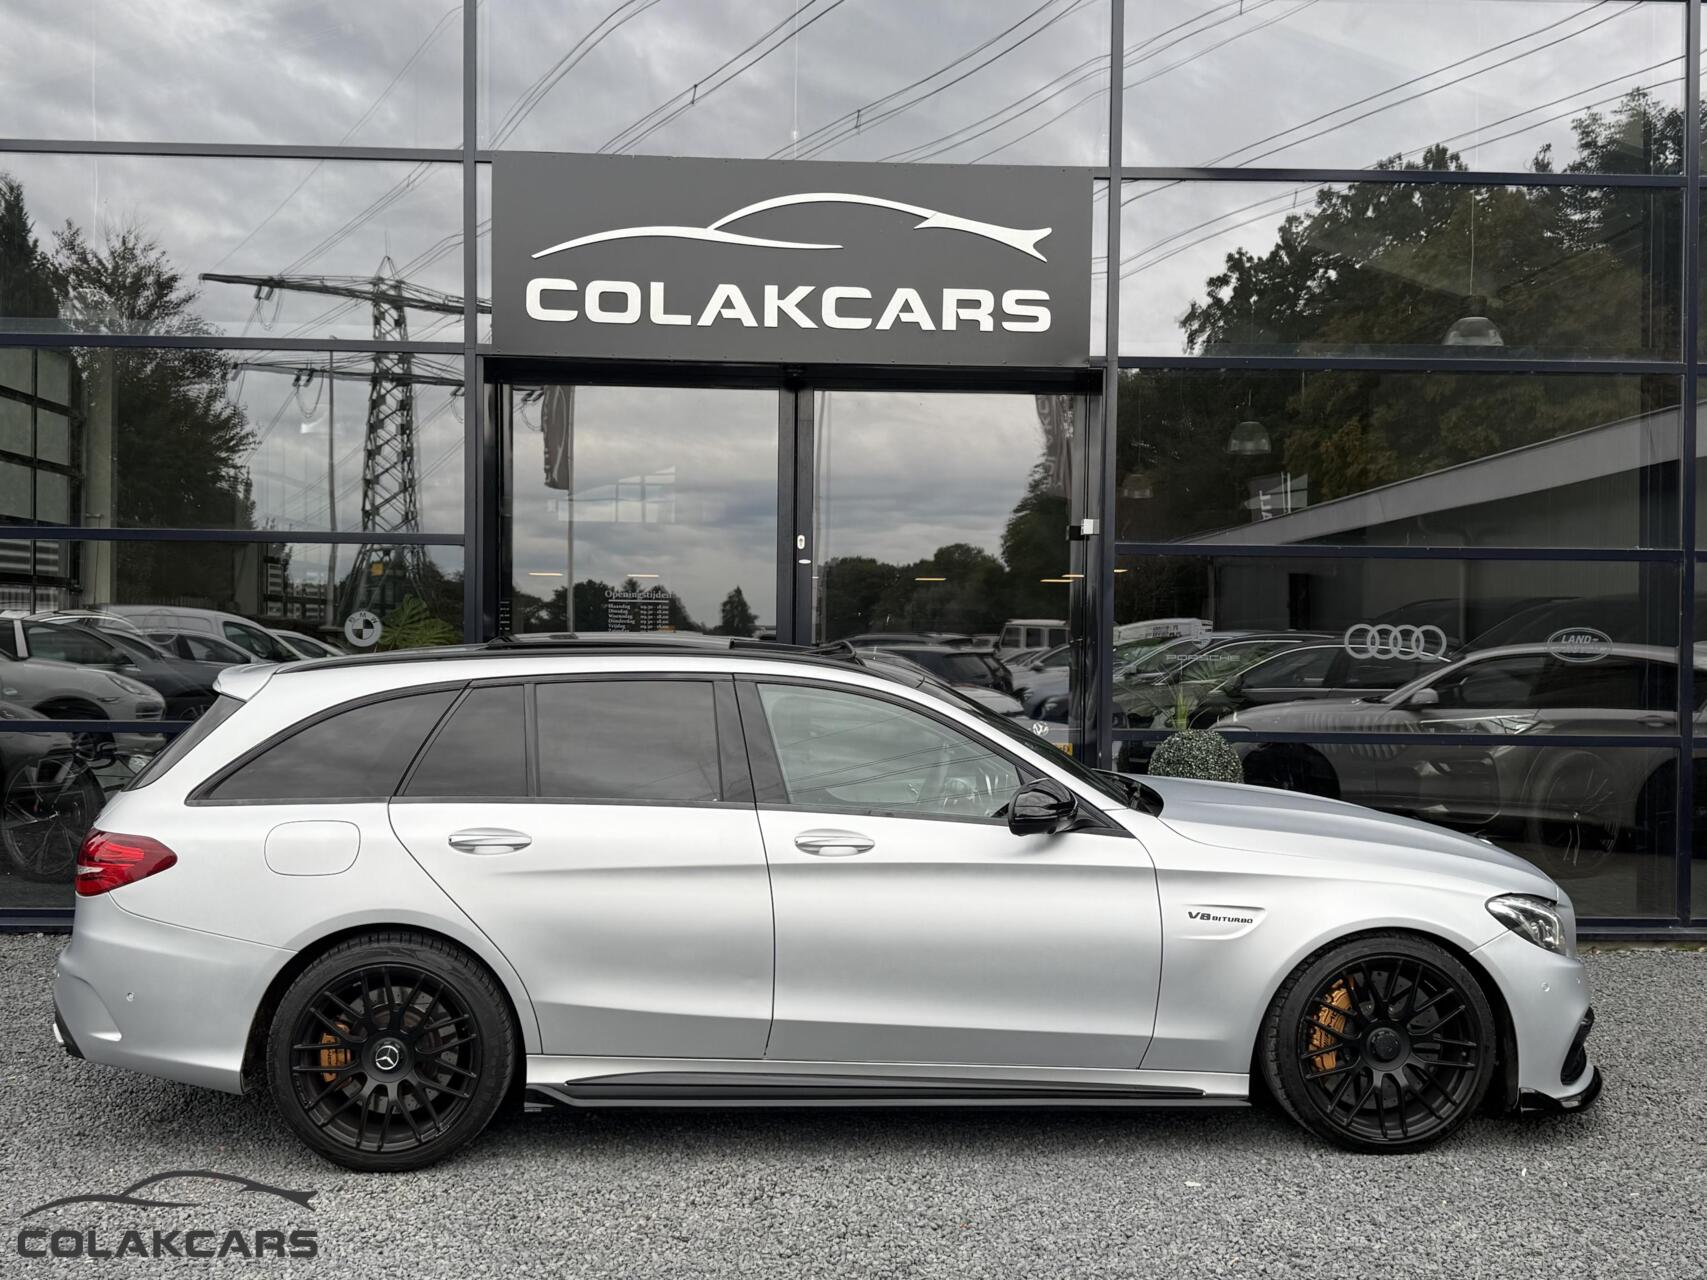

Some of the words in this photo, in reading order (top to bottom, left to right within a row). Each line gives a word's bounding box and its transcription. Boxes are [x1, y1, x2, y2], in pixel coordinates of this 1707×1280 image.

[525, 277, 1052, 333] COLAKCARS
[604, 591, 672, 600] Openingstijden
[1188, 911, 1211, 920] V8
